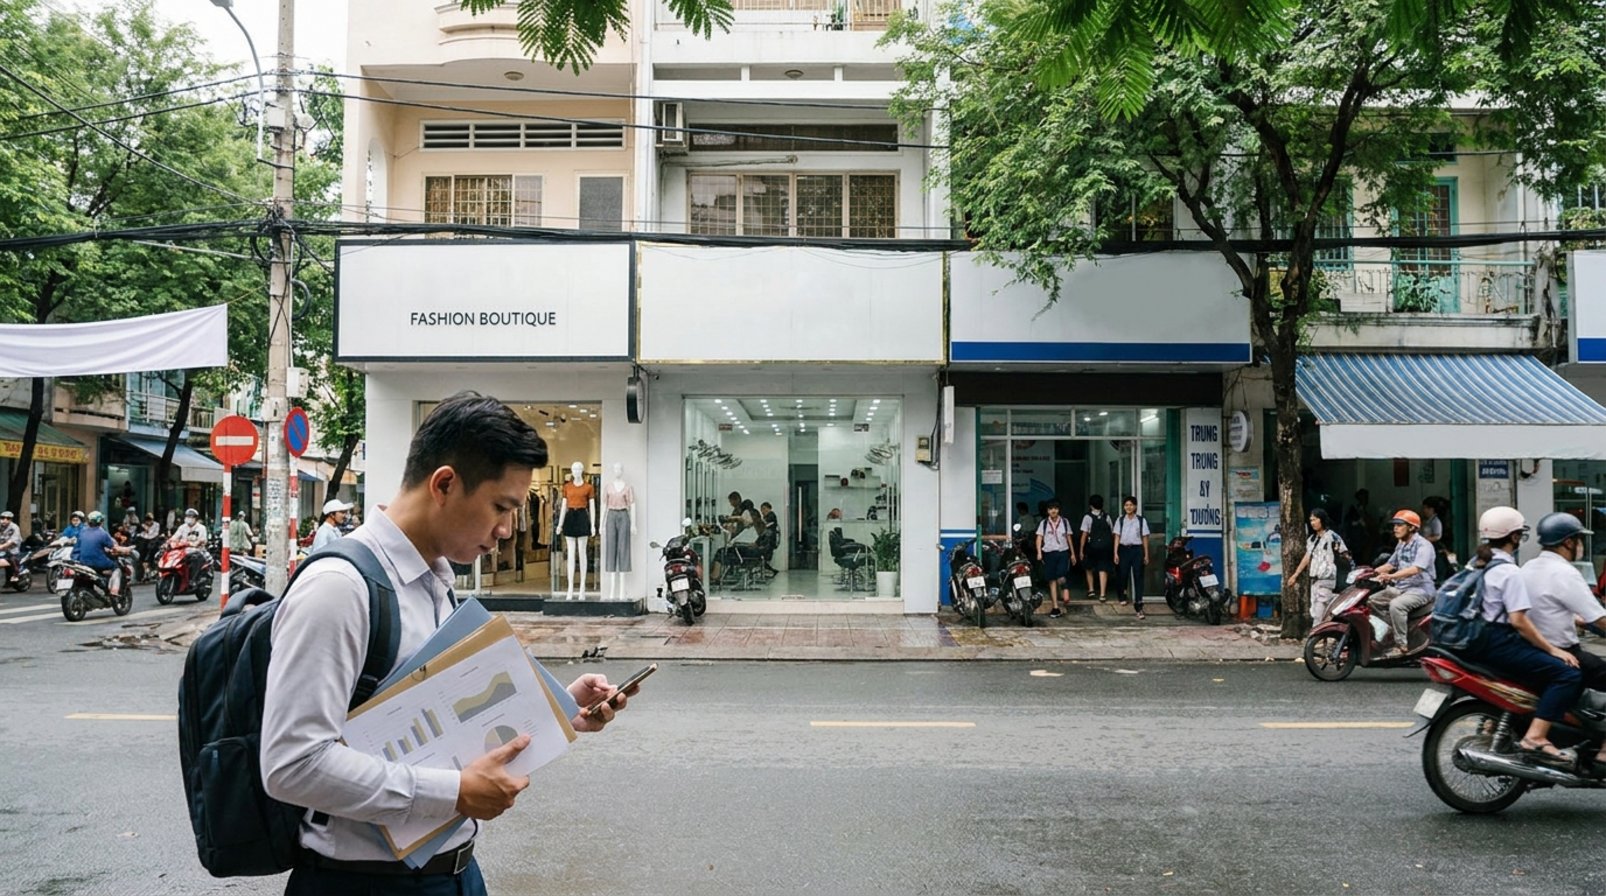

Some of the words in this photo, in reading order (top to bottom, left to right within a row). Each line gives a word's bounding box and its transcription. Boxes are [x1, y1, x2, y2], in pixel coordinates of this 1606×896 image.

[410, 312, 475, 326] FASHION
[479, 312, 556, 327] BOUTIQUE
[1190, 425, 1218, 442] TRUNG
